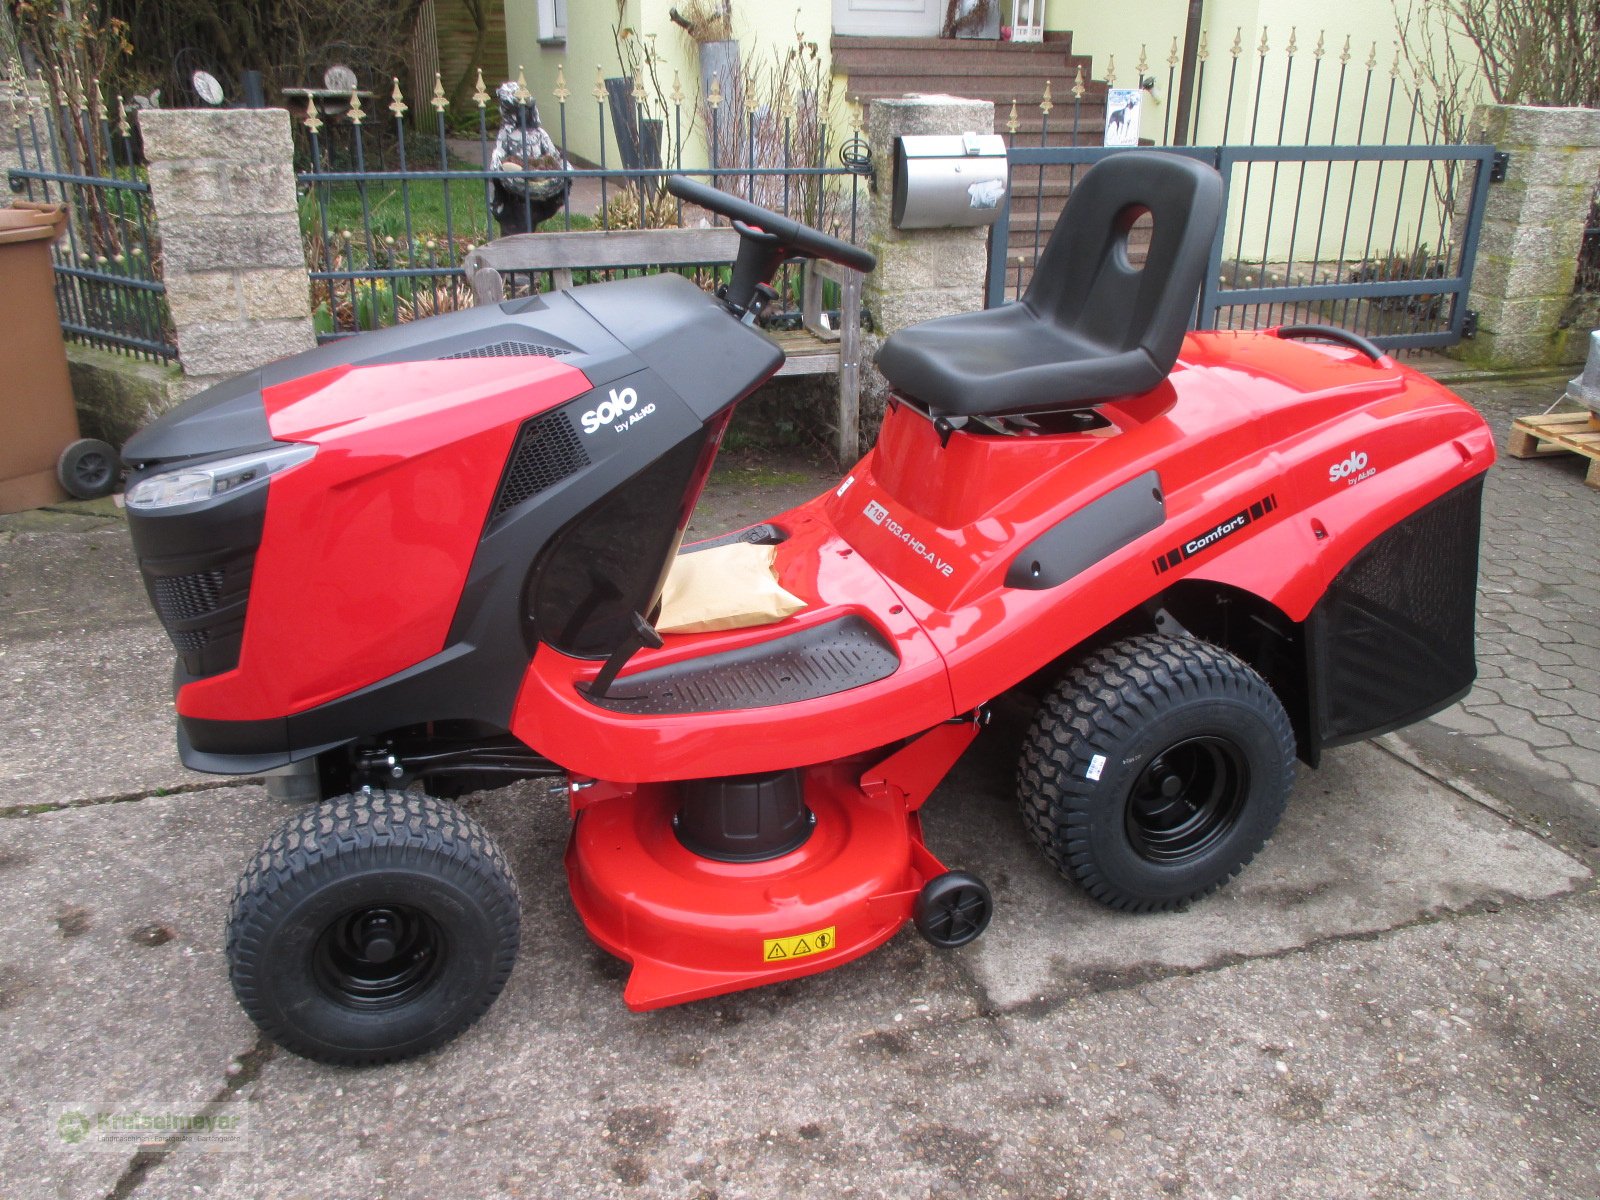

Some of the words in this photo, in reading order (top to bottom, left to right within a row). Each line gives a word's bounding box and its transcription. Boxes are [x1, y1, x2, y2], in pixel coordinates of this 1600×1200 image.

[581, 387, 638, 434] solo
[614, 421, 629, 433] by
[1328, 450, 1368, 482] solo
[1347, 477, 1358, 485] by
[866, 502, 885, 521] T18
[885, 518, 911, 543] 103.4
[908, 537, 935, 564] HD-A
[935, 558, 954, 577] V2
[1185, 515, 1245, 554] Comfort
